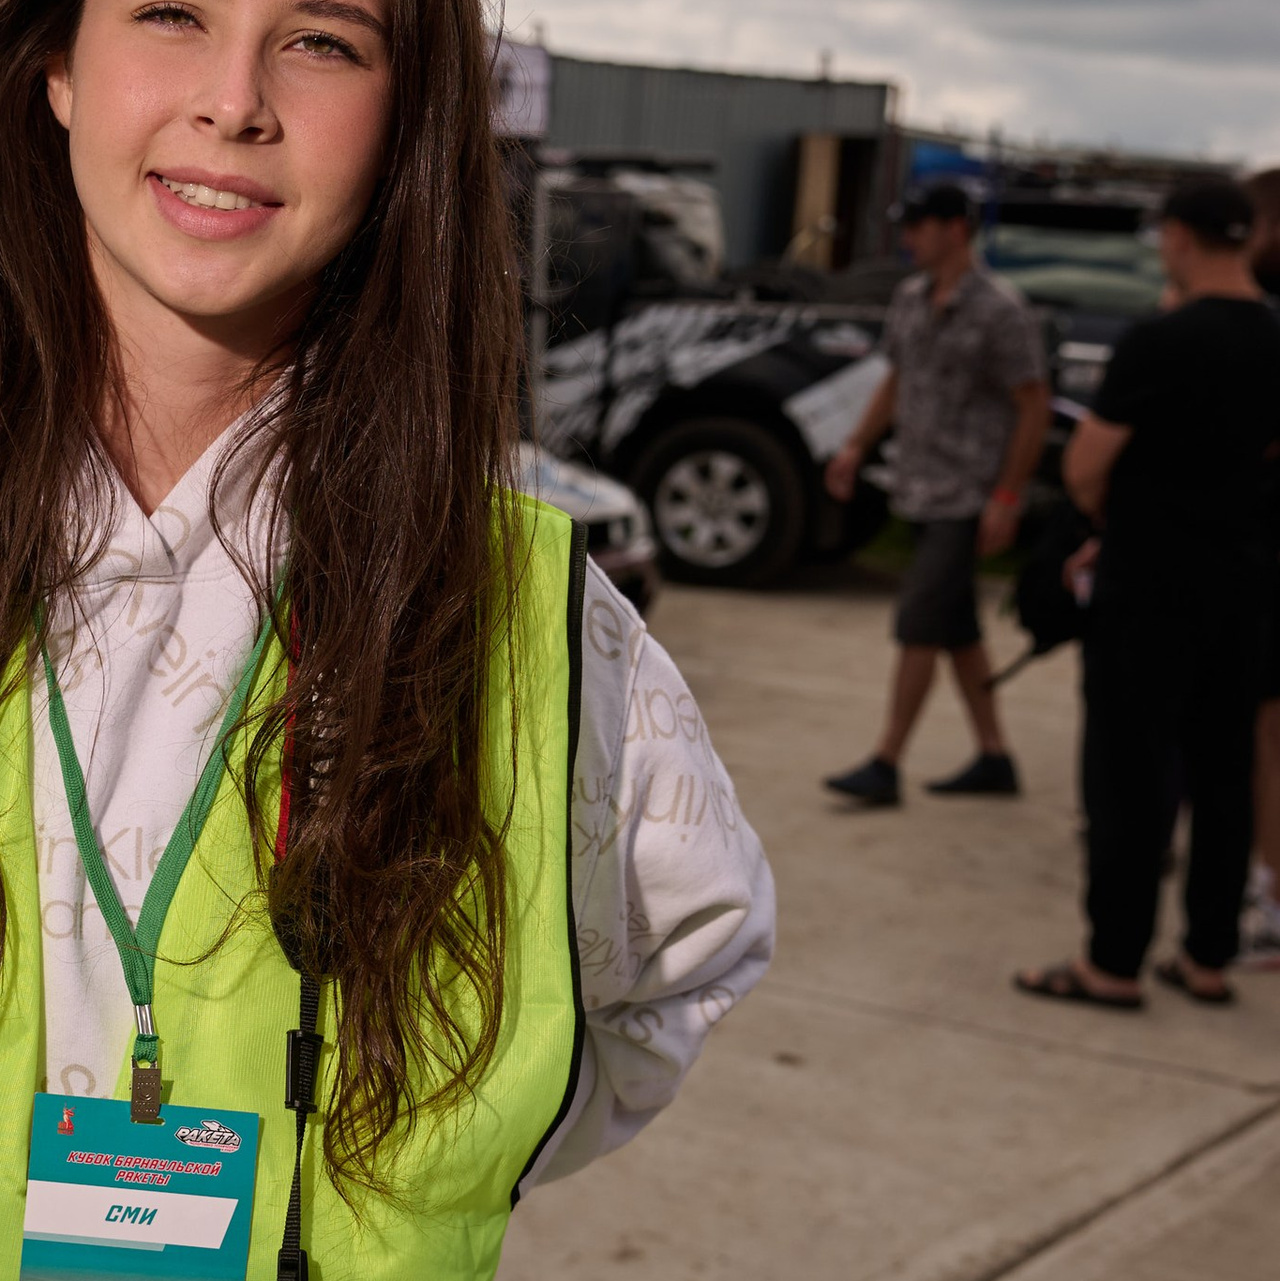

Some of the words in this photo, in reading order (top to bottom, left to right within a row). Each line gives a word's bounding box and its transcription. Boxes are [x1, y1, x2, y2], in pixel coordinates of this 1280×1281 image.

[67, 1151, 113, 1166] КУБОК
[114, 1156, 222, 1176] БАРНАУЛЬСКОЙ
[115, 1170, 171, 1186] РАКЕТЫ
[105, 1205, 158, 1225] СМИ
